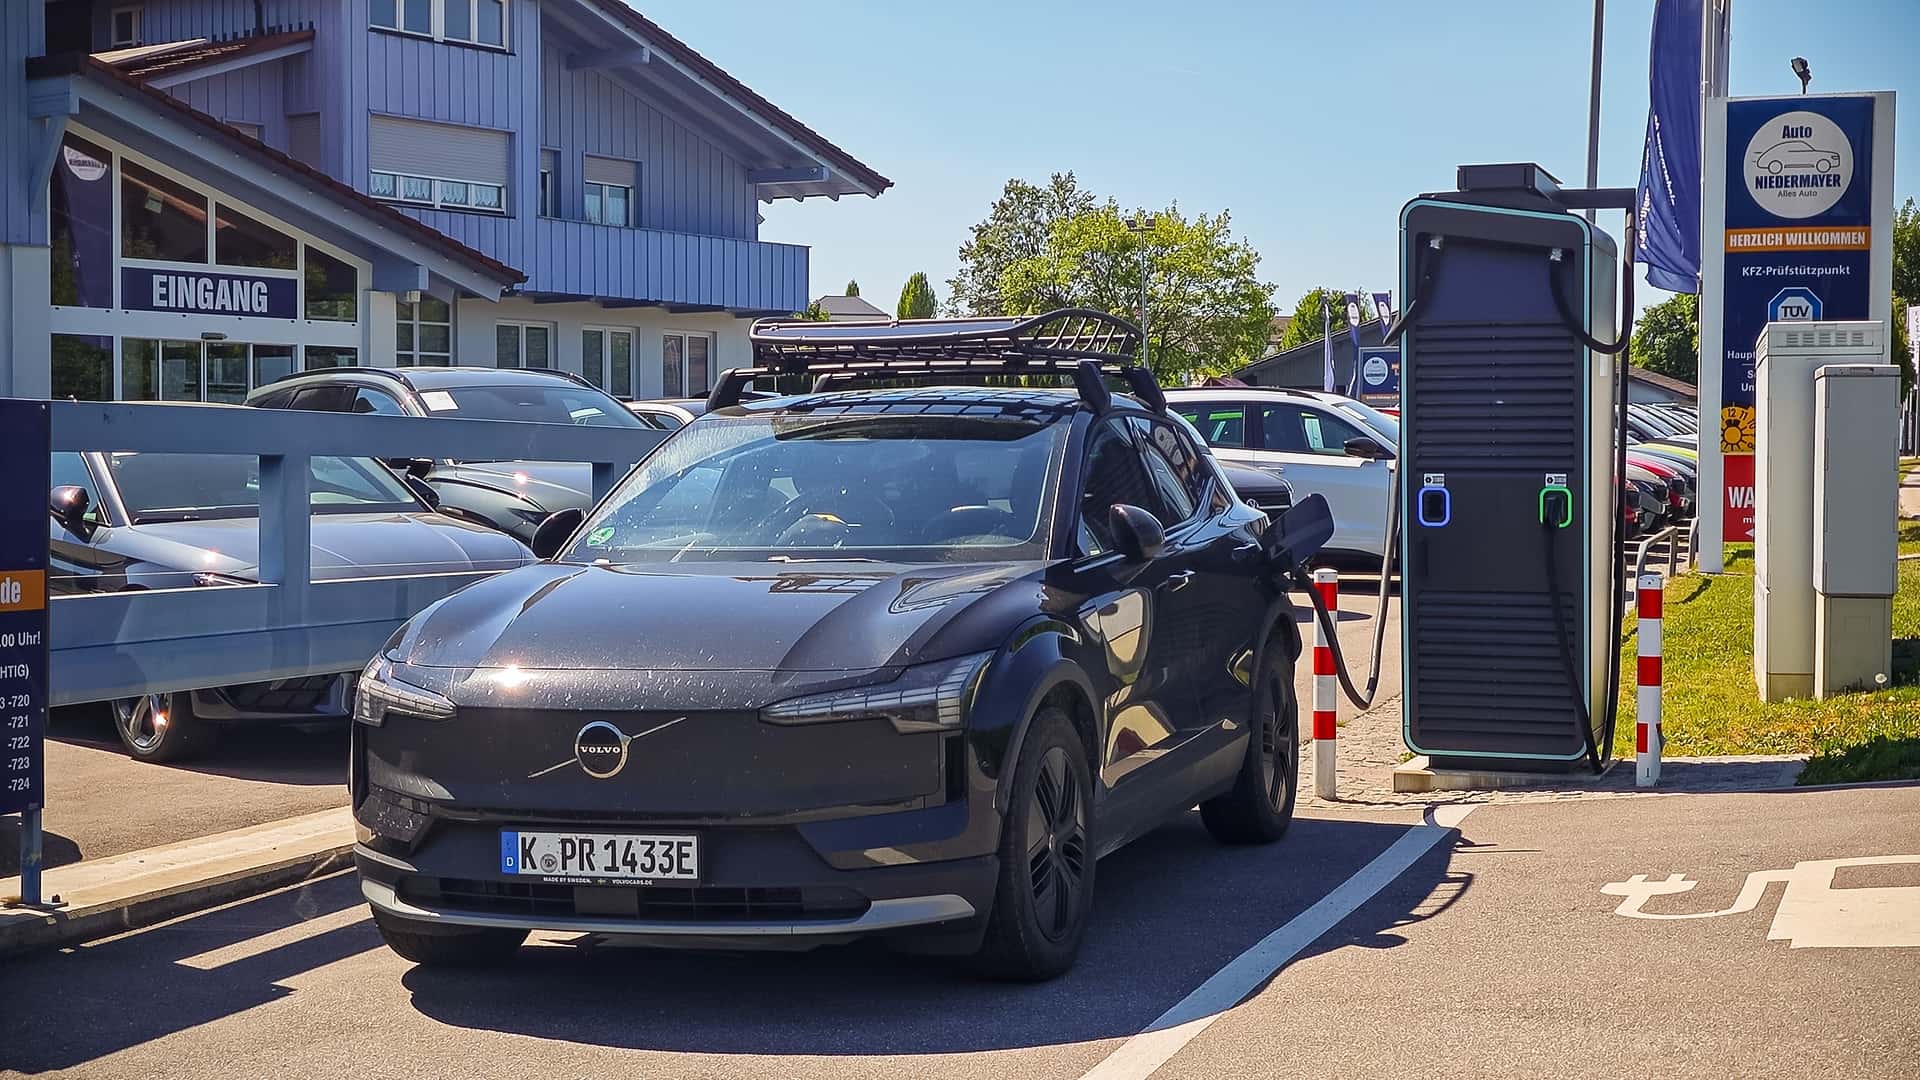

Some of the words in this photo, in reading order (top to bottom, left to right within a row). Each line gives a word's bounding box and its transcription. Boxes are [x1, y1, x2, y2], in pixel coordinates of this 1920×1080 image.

[1782, 125, 1812, 139] Auto
[1755, 174, 1841, 189] NIEDERMAYER
[1777, 190, 1797, 198] Alles
[1798, 189, 1818, 197] Auto
[1729, 233, 1783, 247] HERZLICH
[1785, 231, 1866, 246] WILLKOMMEN
[1742, 265, 1851, 278] KFZ-Prüfstützpunkt
[152, 274, 268, 313] EINGANG
[1781, 304, 1809, 318] TÜV
[1747, 369, 1757, 379] S
[1728, 408, 1737, 418] 12
[1, 576, 21, 605] de
[18, 630, 41, 646] Uhr!
[8, 714, 29, 728] -721
[8, 736, 30, 750] -722
[580, 746, 621, 754] VOLVO
[8, 756, 30, 771] -723
[8, 777, 30, 791] -724
[506, 857, 514, 867] D
[520, 836, 538, 870] K
[560, 838, 596, 872] PR
[603, 839, 695, 875] 1433E
